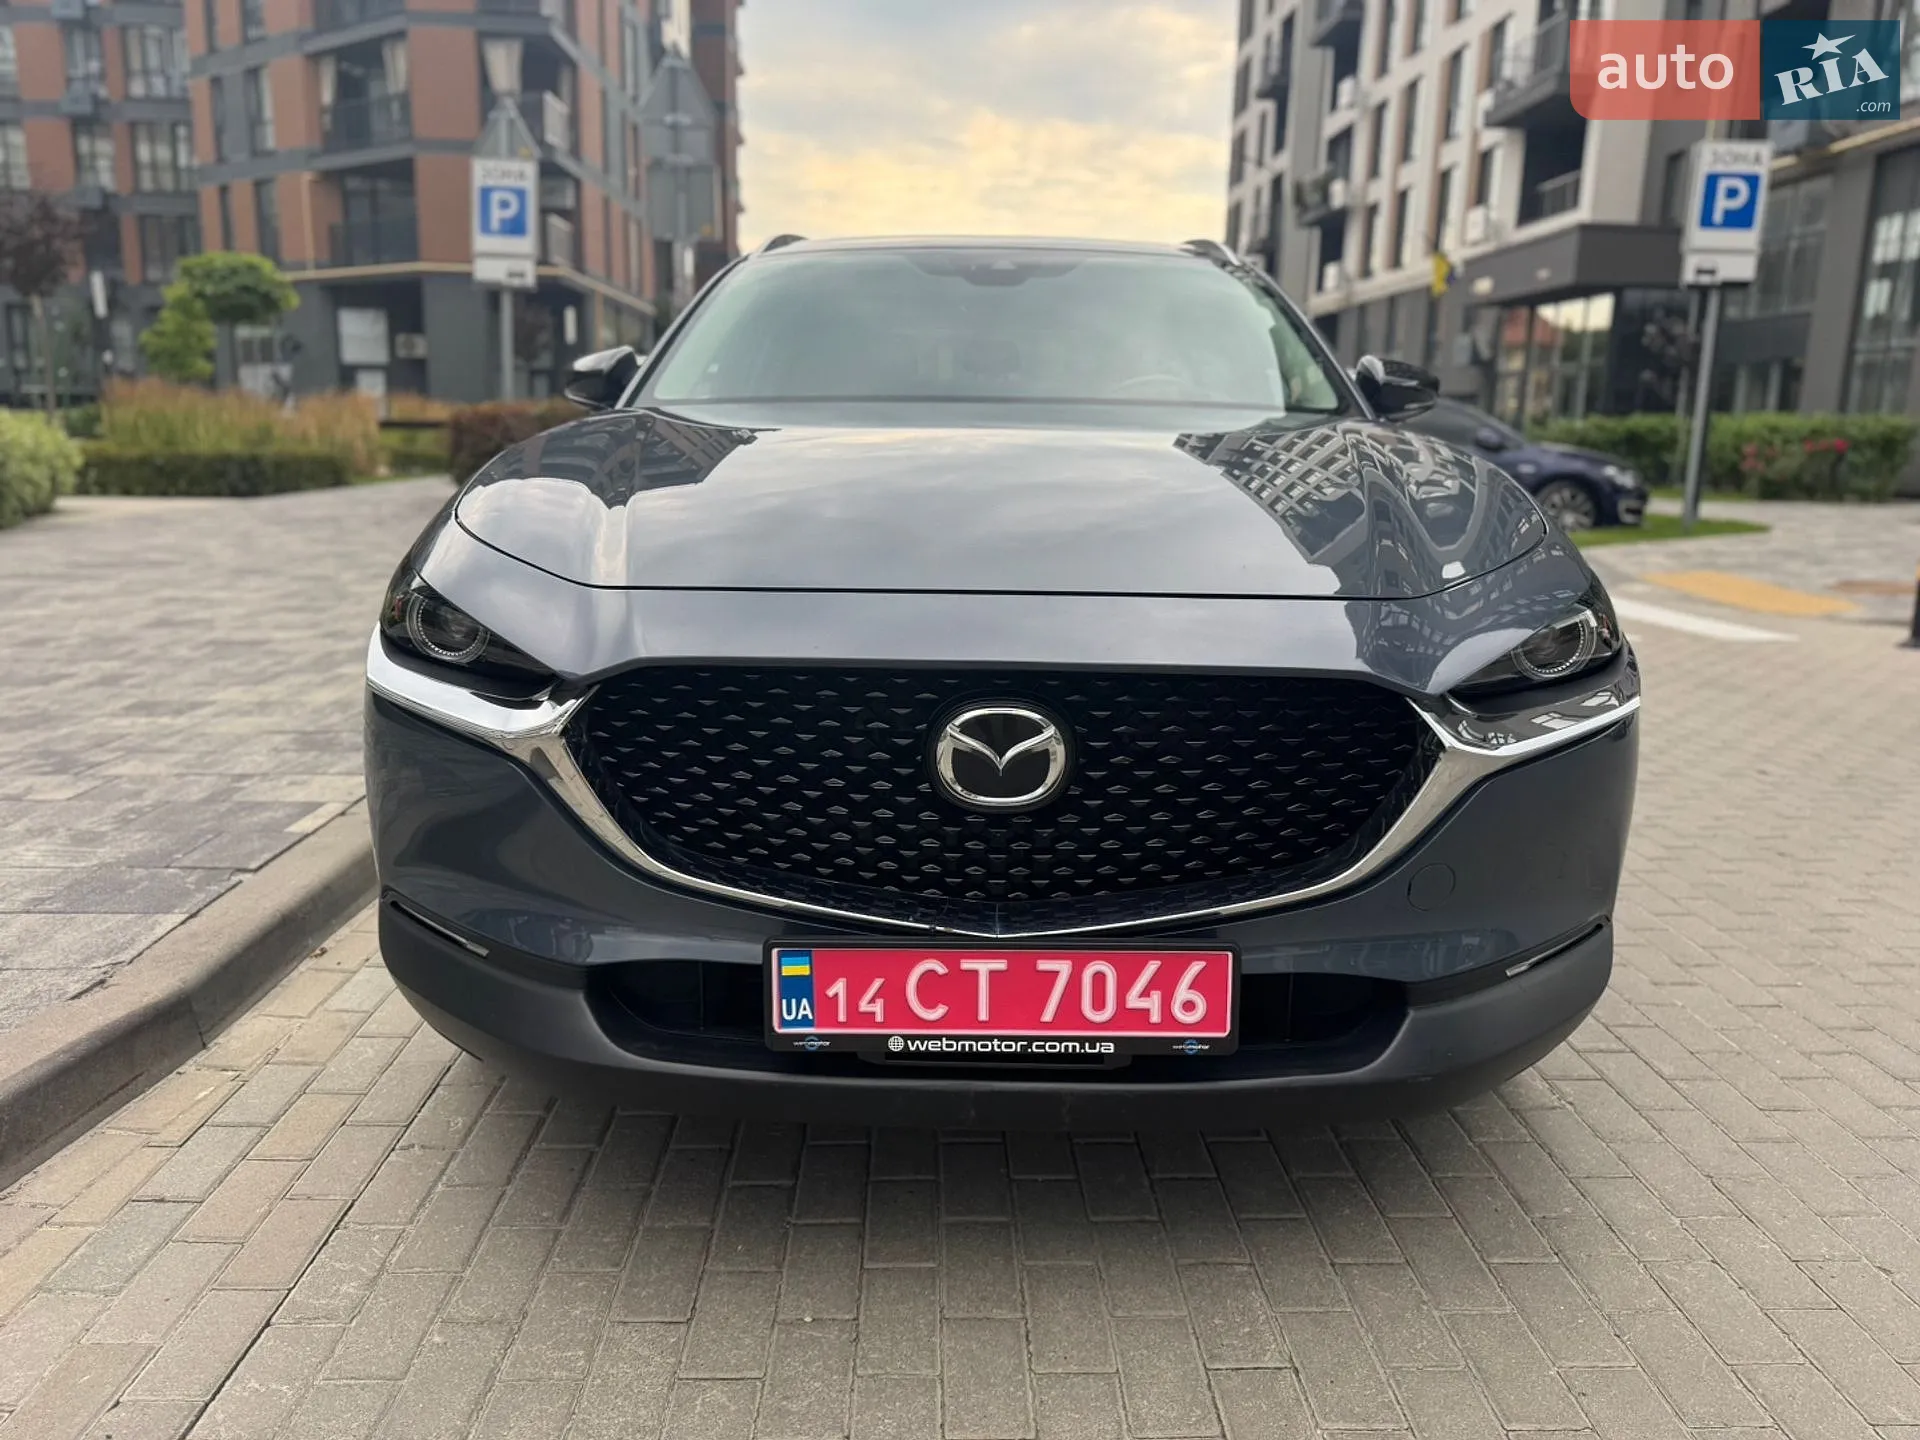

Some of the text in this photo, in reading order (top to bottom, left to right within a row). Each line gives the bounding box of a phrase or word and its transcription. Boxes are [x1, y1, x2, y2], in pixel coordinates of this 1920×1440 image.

[490, 191, 519, 231] P
[1711, 178, 1749, 225] P
[782, 998, 813, 1021] UA
[825, 977, 885, 1023] 14
[1035, 961, 1207, 1024] 7046
[907, 1036, 1115, 1054] webmotor.com.ua
